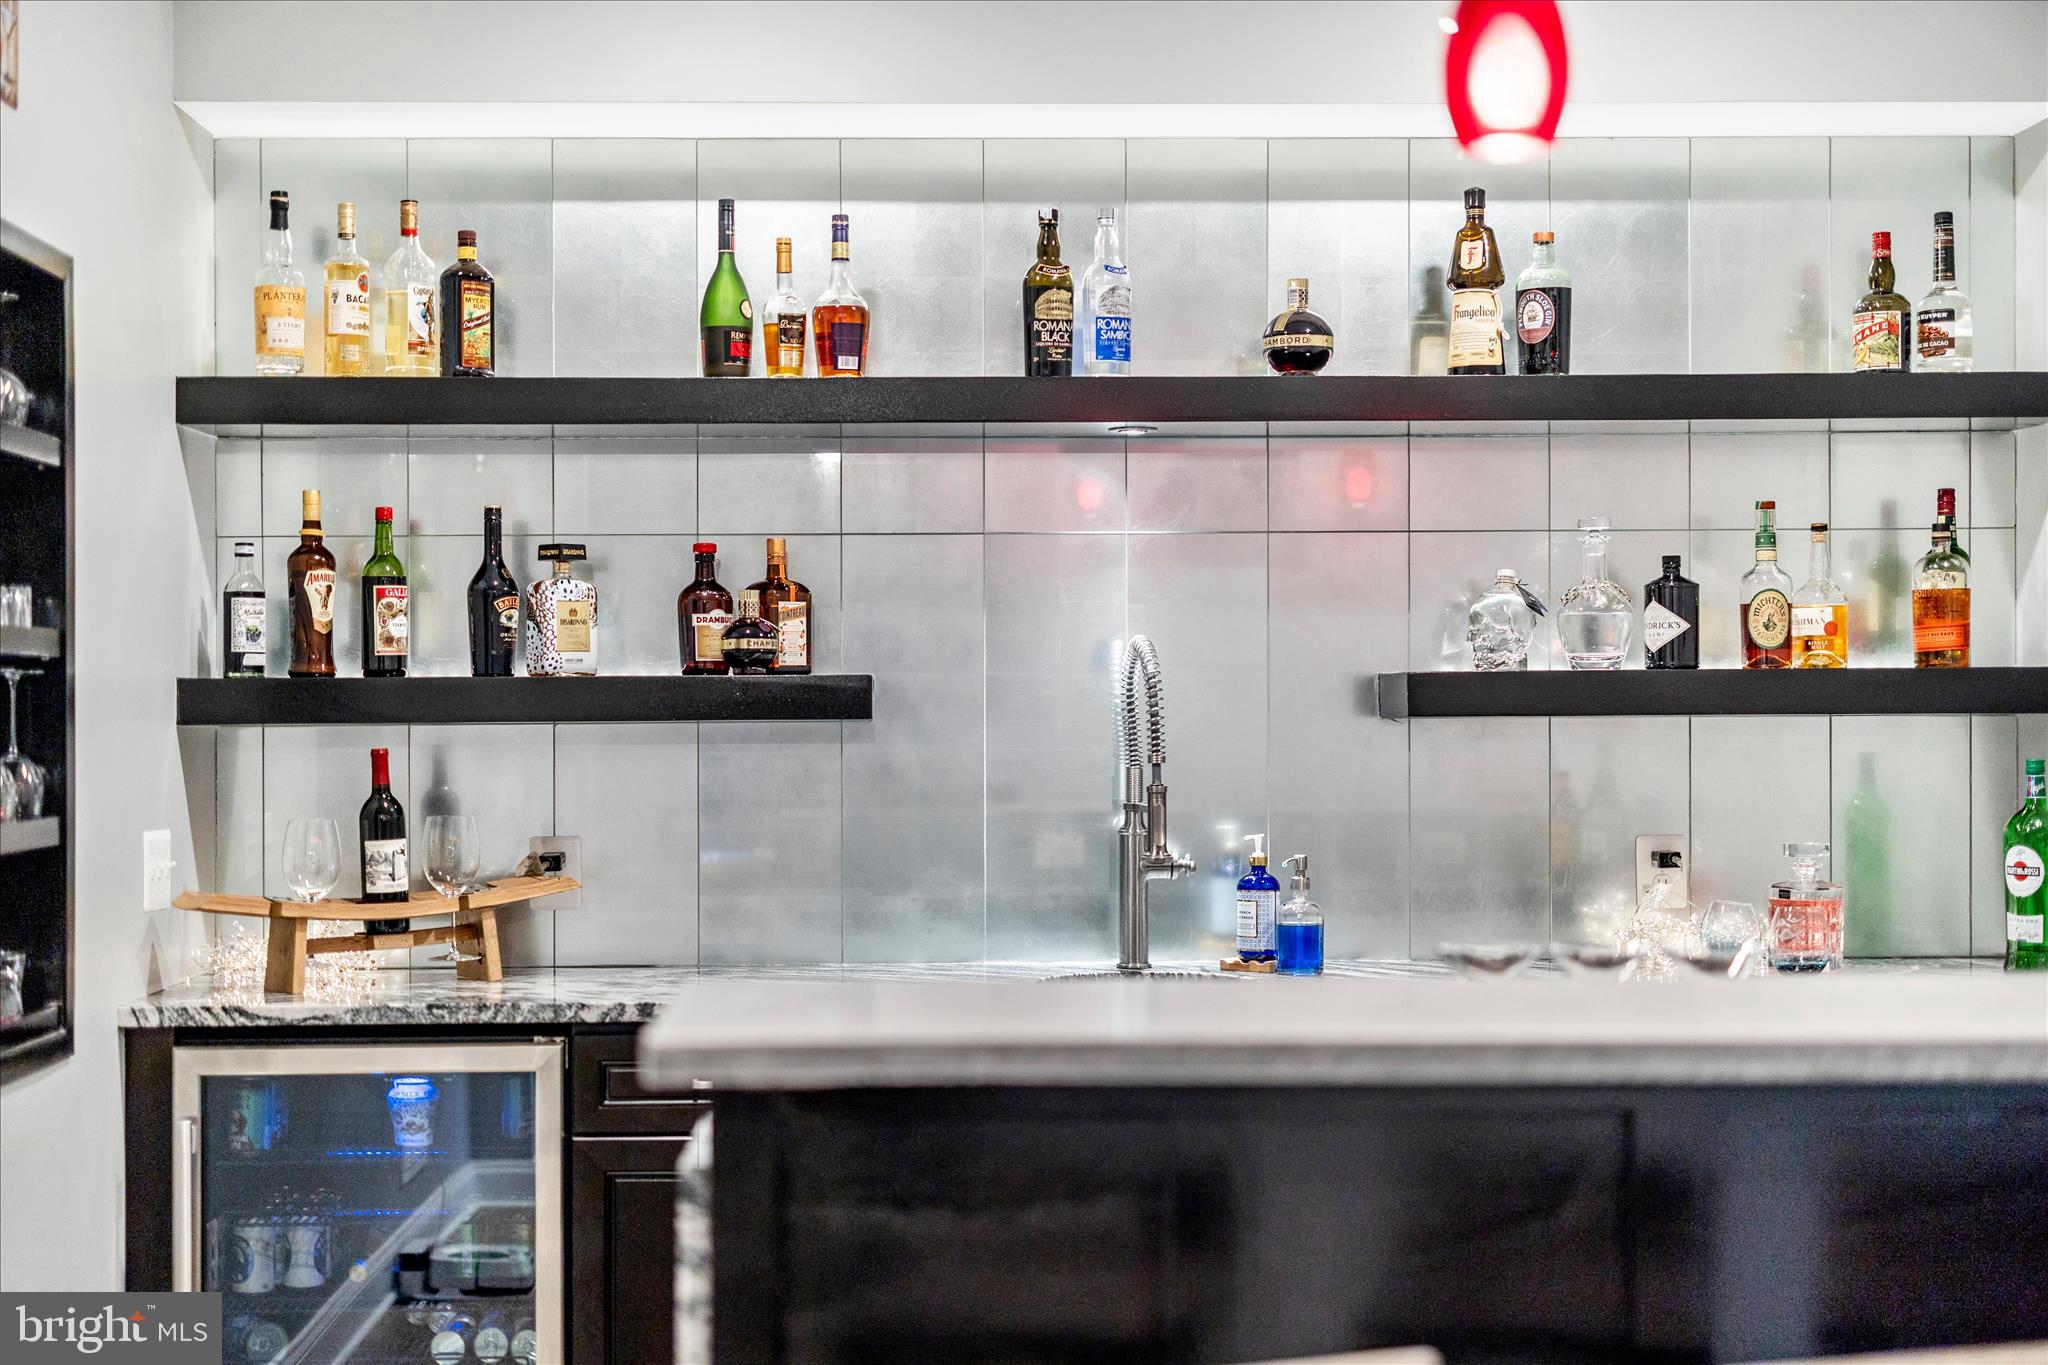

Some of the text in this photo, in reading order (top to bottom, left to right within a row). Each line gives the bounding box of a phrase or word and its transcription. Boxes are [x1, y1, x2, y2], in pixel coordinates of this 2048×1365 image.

[1454, 303, 1496, 322] Frangelico
[1518, 293, 1553, 328] PLYMOUTH SLOE GIN
[1920, 312, 1949, 320] KUYPER
[1097, 319, 1131, 330] ROMAN
[1041, 331, 1070, 342] BLACK
[560, 618, 588, 626] DISARONNO
